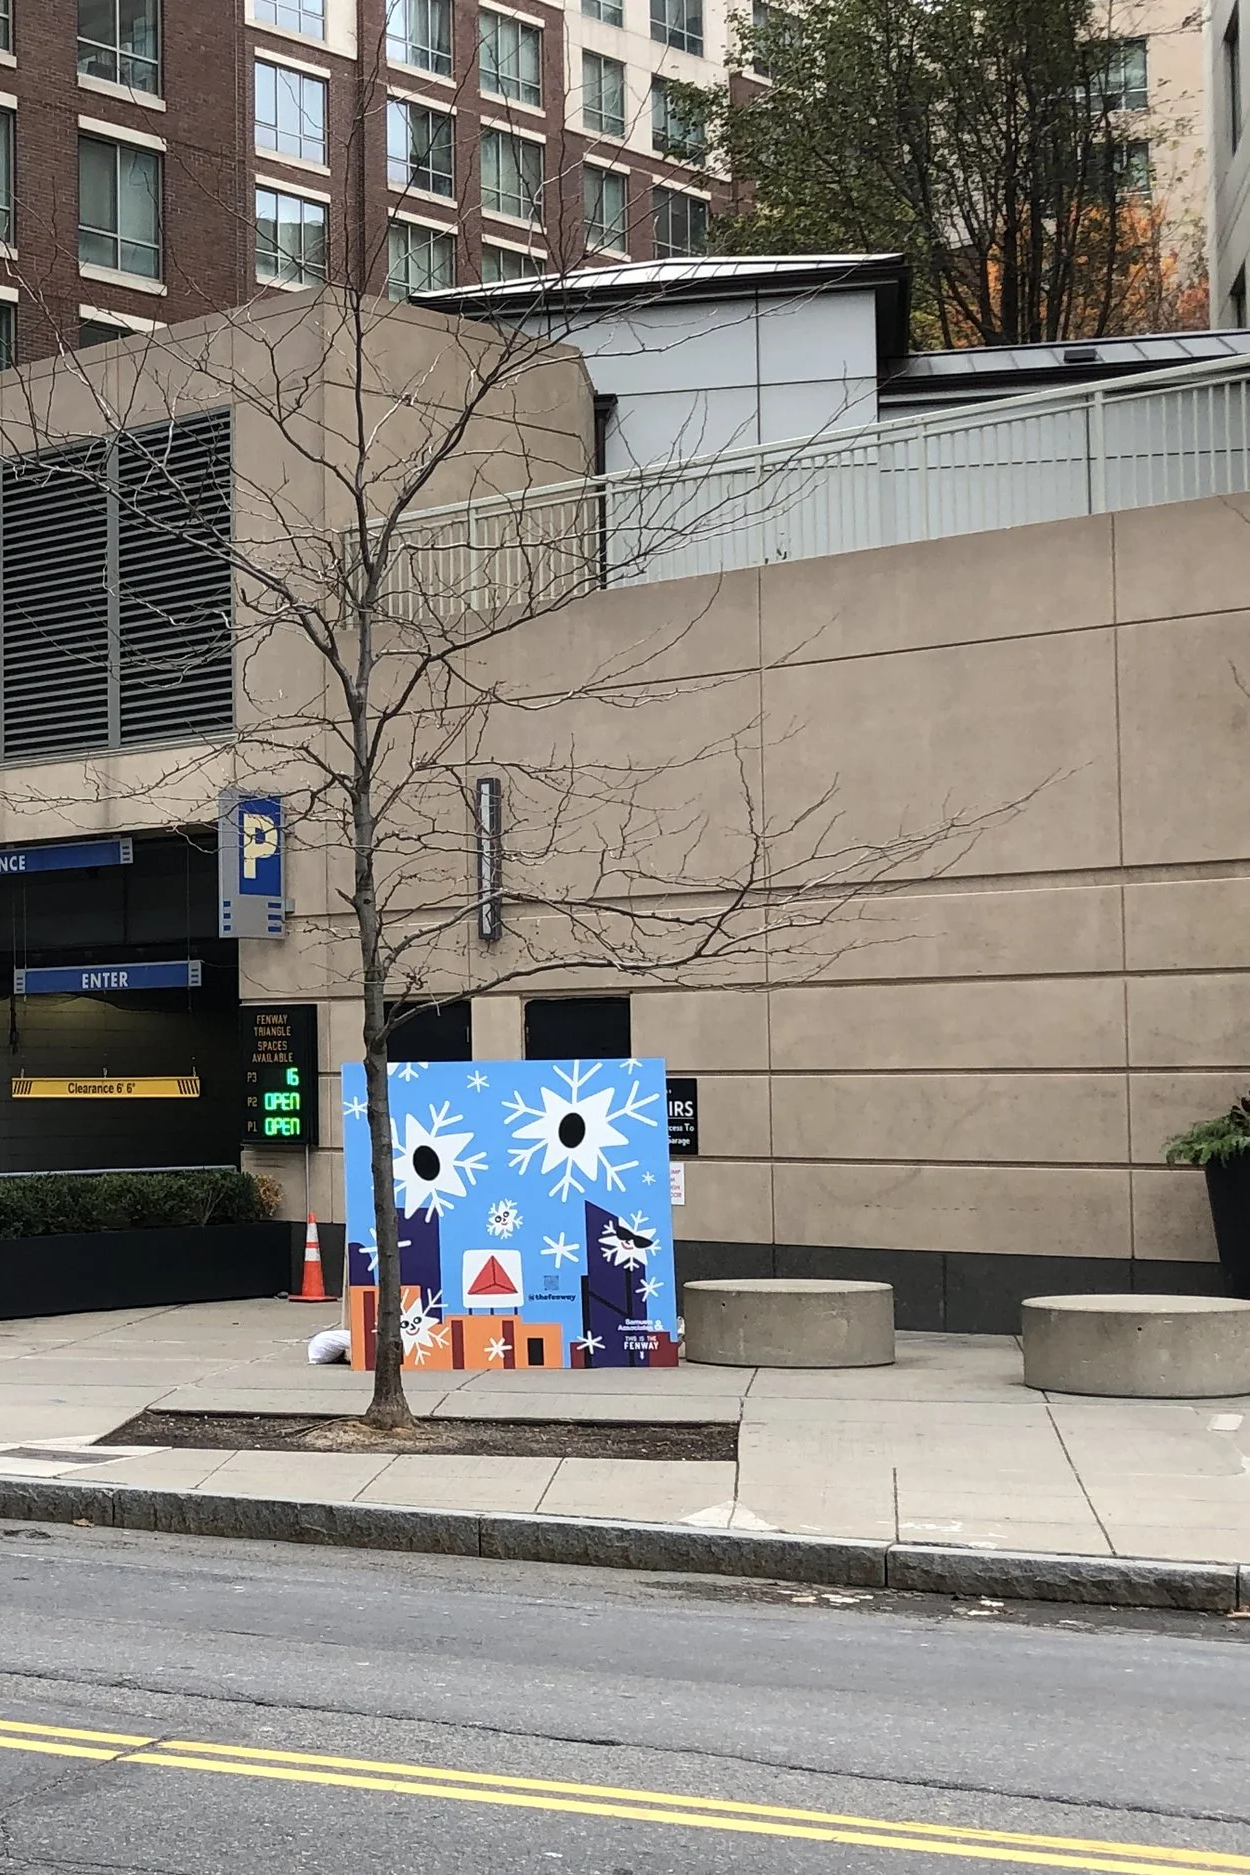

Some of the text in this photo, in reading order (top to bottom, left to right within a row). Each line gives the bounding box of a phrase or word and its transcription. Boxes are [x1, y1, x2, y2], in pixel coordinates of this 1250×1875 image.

[243, 813, 279, 879] P
[82, 971, 129, 989] ENTER
[256, 1014, 288, 1025] FENWAY
[254, 1026, 291, 1037] TRIANGLE
[257, 1041, 288, 1051] SPACES
[252, 1052, 293, 1063] AVAILABLE
[247, 1072, 257, 1083] P3
[67, 1082, 115, 1094] Clearance
[247, 1092, 300, 1111] P2 OPEN
[669, 1100, 694, 1117] IRS
[247, 1117, 300, 1136] P1 OPEN
[528, 1293, 576, 1302] @thefenway
[623, 1341, 659, 1350] FENWAY
